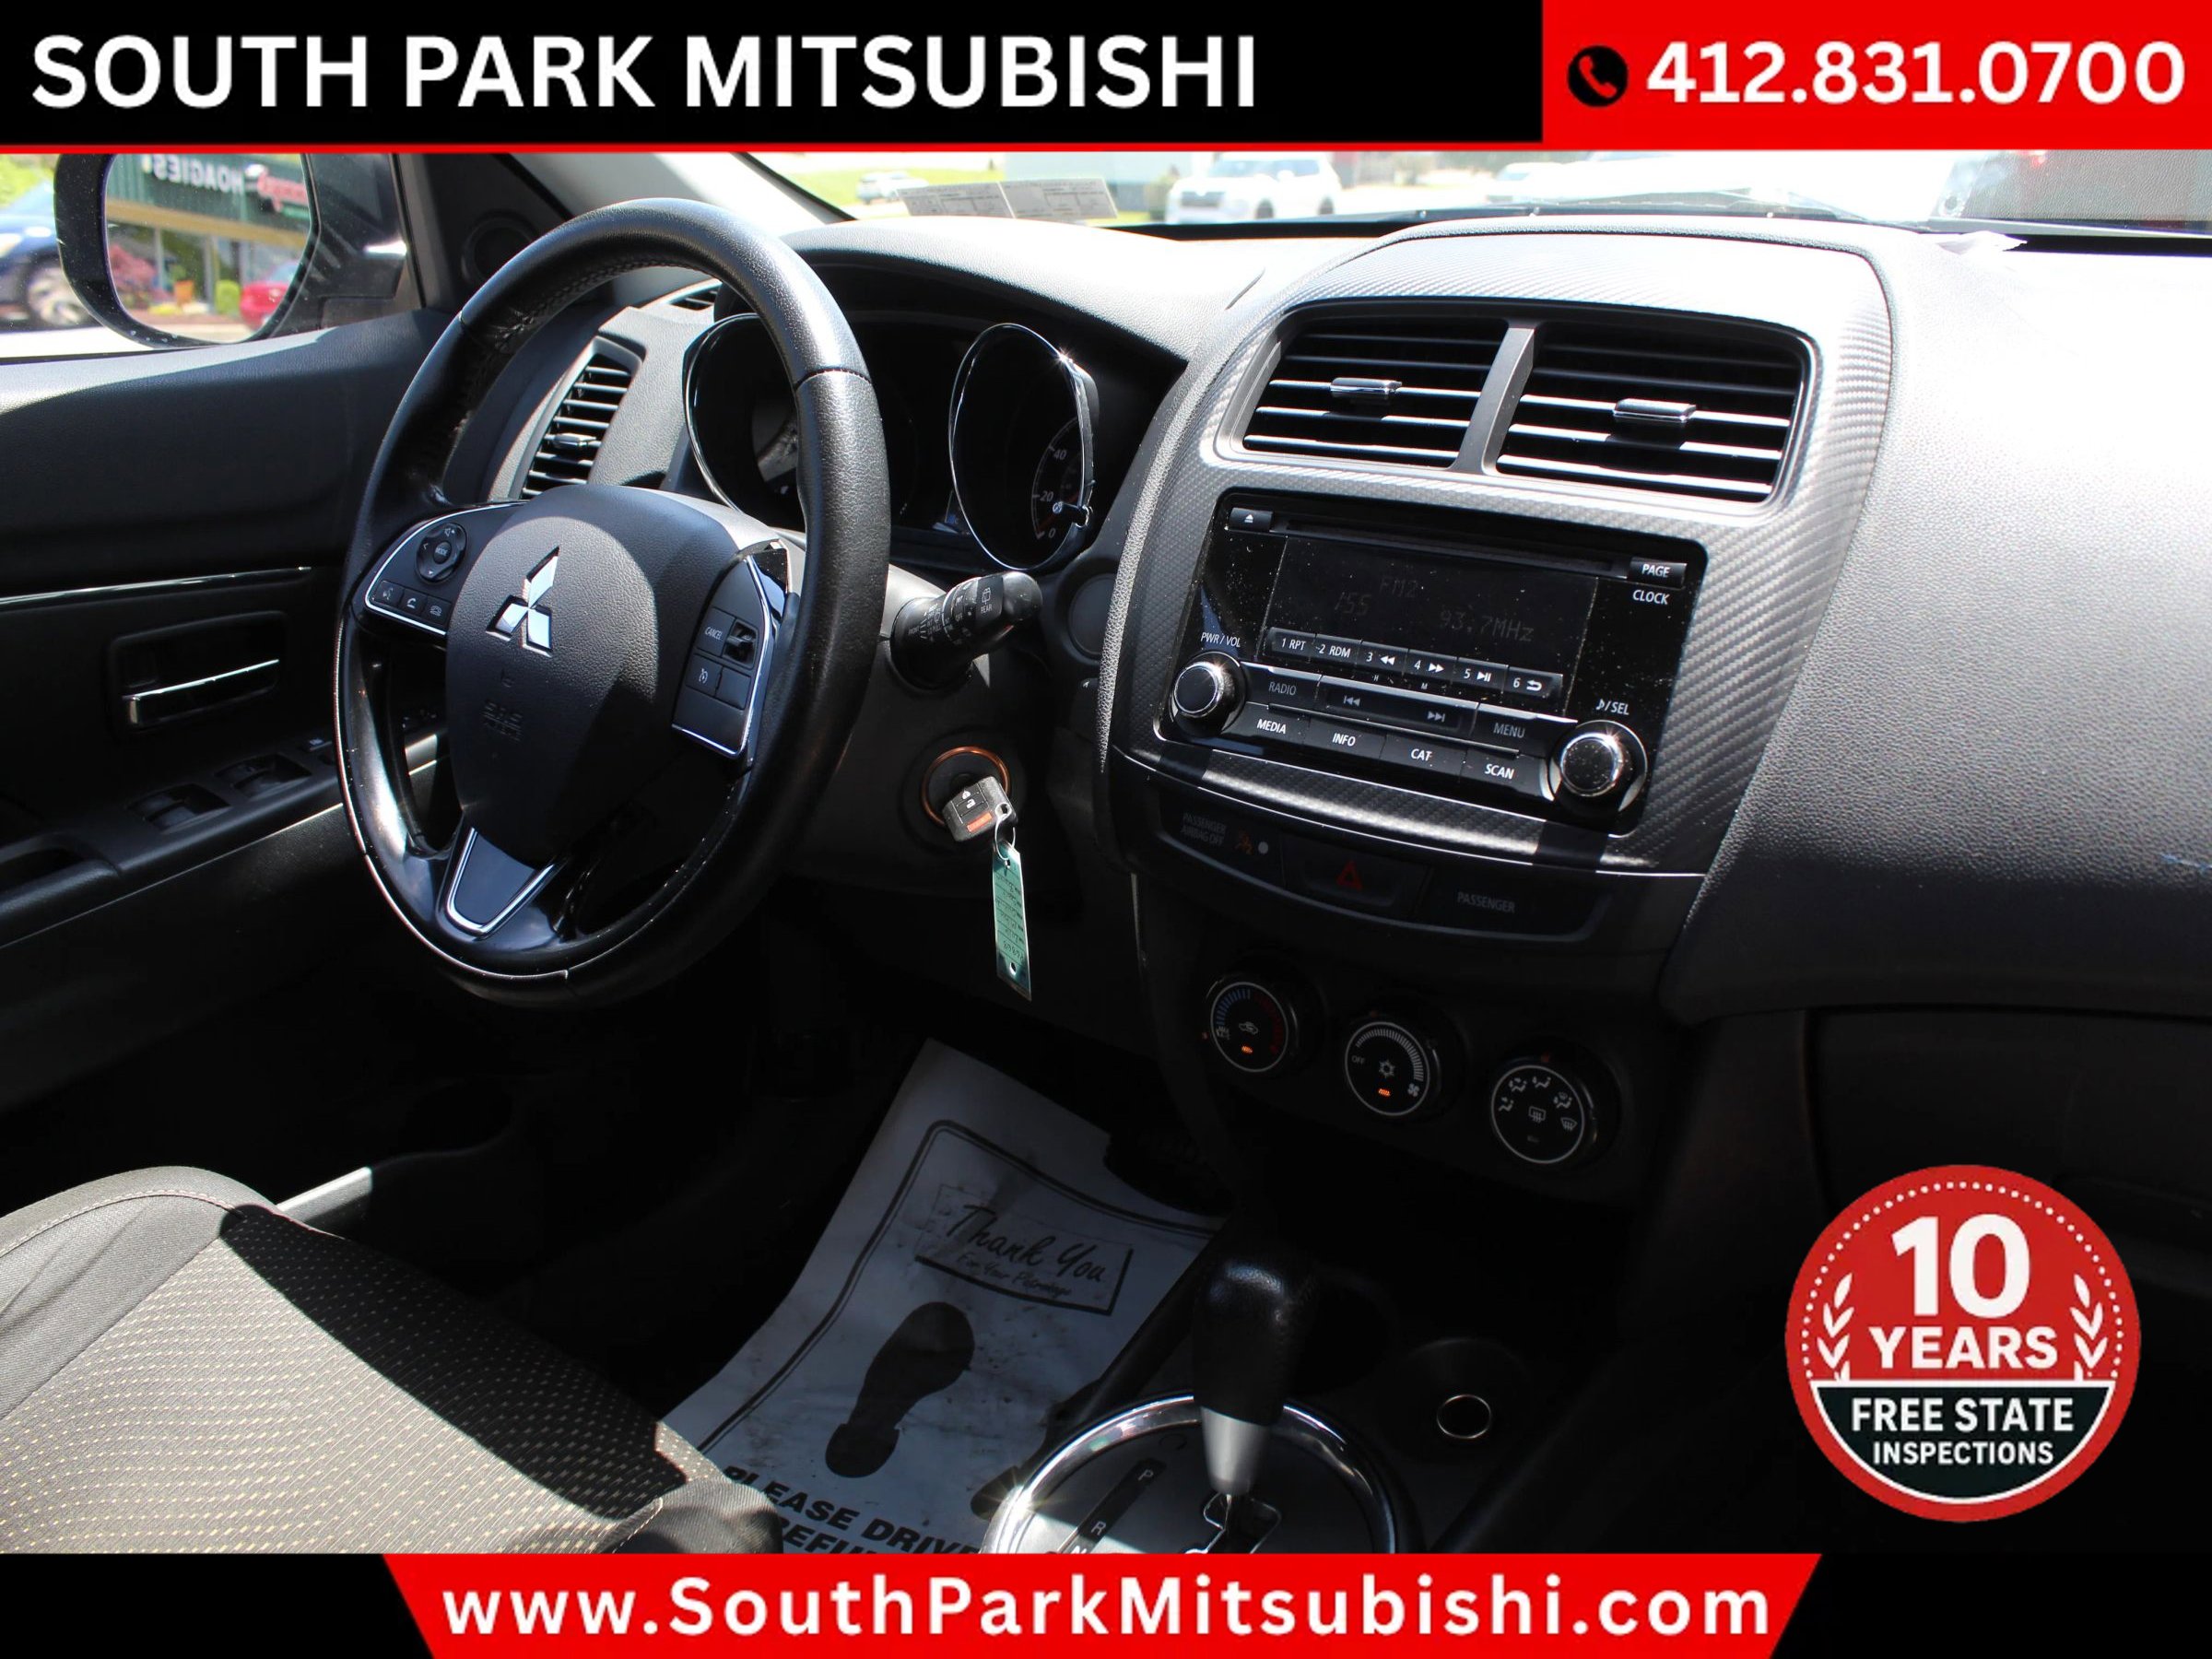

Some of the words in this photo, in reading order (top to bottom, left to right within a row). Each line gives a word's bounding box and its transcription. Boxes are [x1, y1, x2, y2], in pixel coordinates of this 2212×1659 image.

[1040, 490, 1054, 502] 20
[1641, 563, 1672, 578] PAGE
[1632, 589, 1671, 606] CLOCK
[704, 626, 724, 641] CANCEL
[1288, 639, 1308, 652] RPT
[1328, 645, 1352, 659] RDM
[1365, 651, 1373, 663] 3
[1412, 659, 1421, 671] 4
[1463, 667, 1472, 679] 5
[1267, 681, 1298, 698] RADIO
[1512, 677, 1521, 688] 6
[1256, 718, 1288, 735] MEDIA
[1492, 721, 1526, 739] MENU
[1332, 732, 1357, 747] INFO
[1410, 747, 1433, 763] CAT
[1484, 762, 1514, 781] SCAN
[1456, 889, 1516, 914] PASSENGER
[945, 1203, 1056, 1266] Thank
[1055, 1242, 1107, 1284] You
[1137, 1468, 1155, 1482] P
[1090, 1520, 1106, 1535] R
